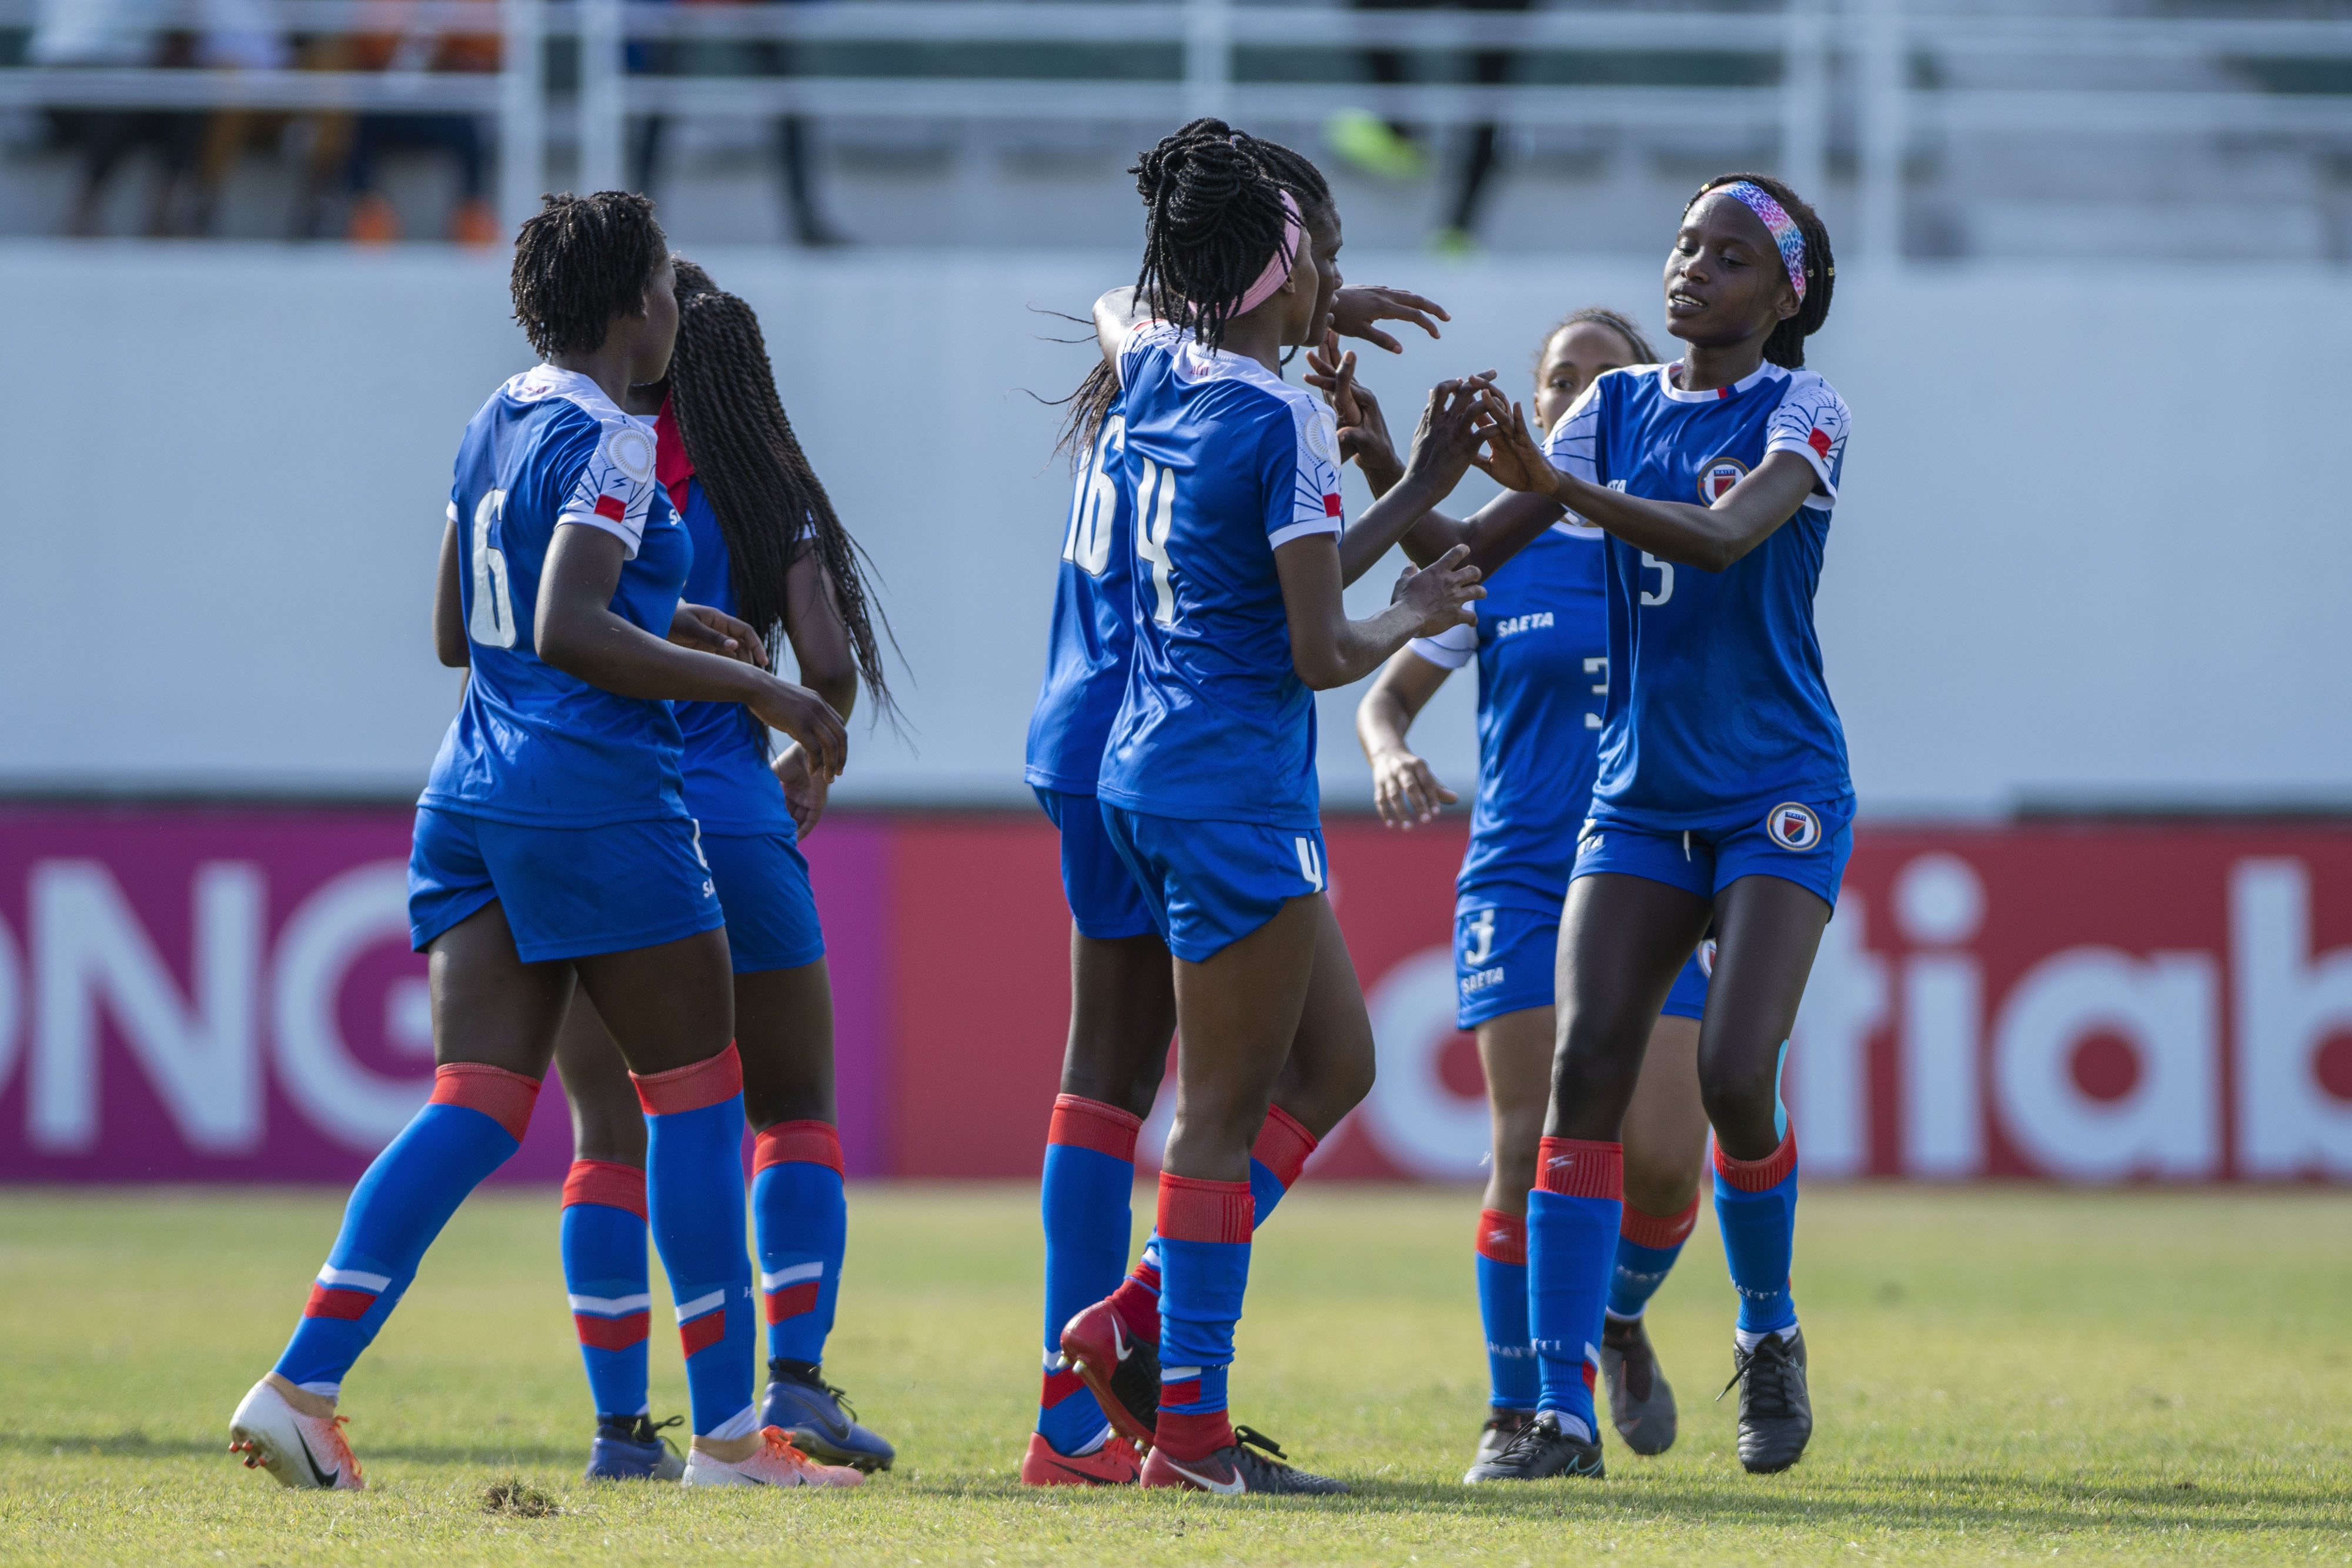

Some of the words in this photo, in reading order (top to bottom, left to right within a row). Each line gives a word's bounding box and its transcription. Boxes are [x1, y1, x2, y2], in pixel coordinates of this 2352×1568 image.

[1062, 414, 1125, 577] 16
[1137, 457, 1176, 625] 4
[469, 488, 517, 650] 6
[1496, 611, 1554, 638] SAETA
[1295, 837, 1323, 894] 4
[1461, 967, 1505, 994] SAETA
[1465, 908, 1495, 966] 3
[0, 855, 436, 1158] NG
